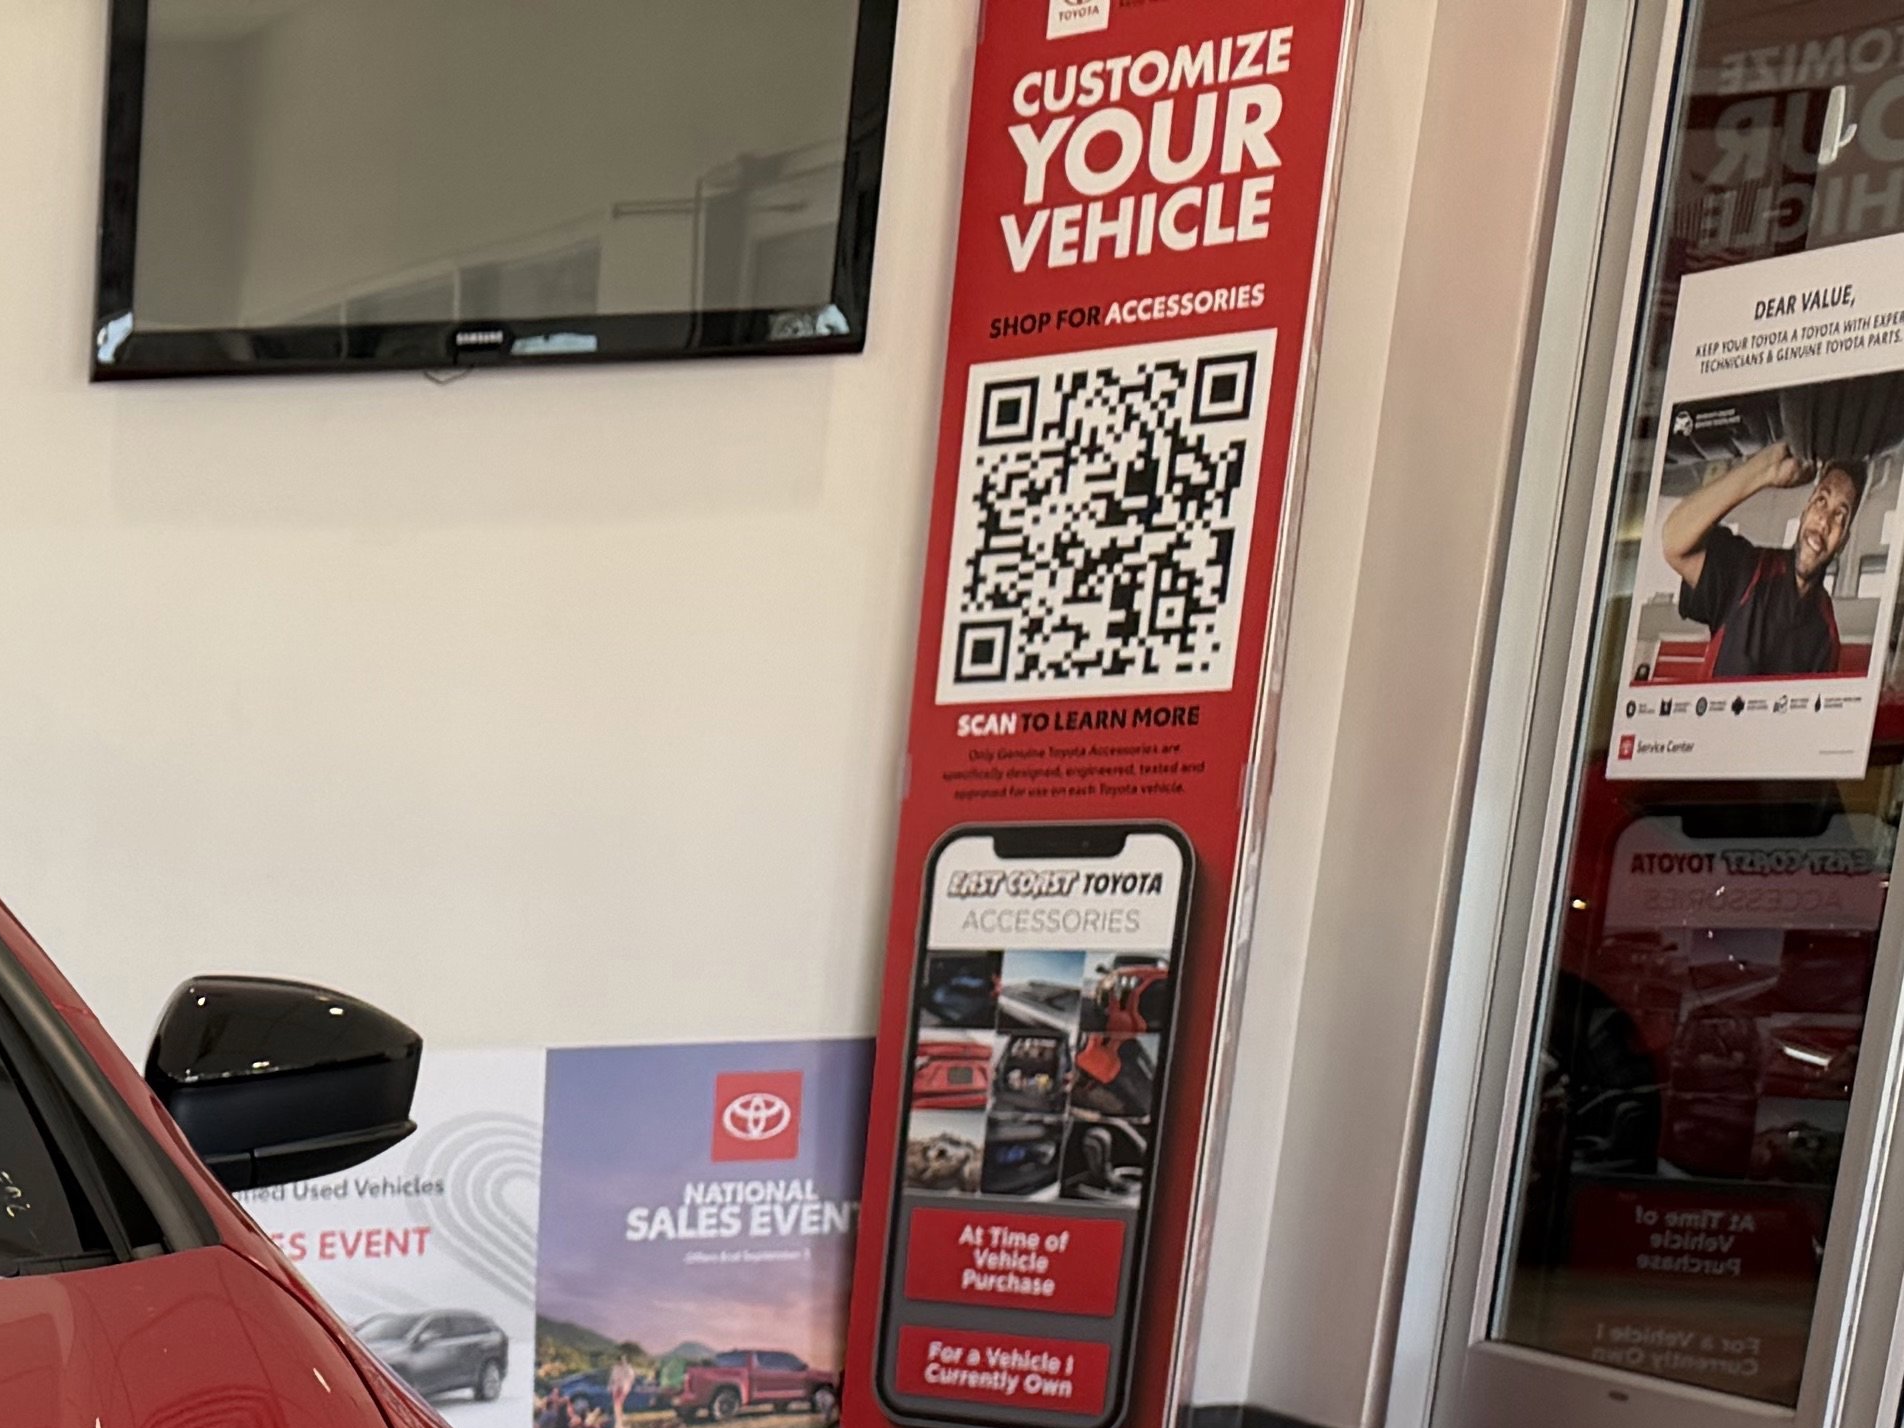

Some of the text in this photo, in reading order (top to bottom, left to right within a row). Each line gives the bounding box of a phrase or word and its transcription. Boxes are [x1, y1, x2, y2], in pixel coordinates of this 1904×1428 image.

[1059, 5, 1099, 22] TOYOTA
[1012, 26, 1293, 117] CUSTOMIZE
[1007, 83, 1283, 205] YOUR
[1000, 174, 1274, 273] VEHICLE
[989, 283, 1265, 339] SHOP FOR ACCESSORIES
[1754, 284, 1856, 320] DEAR VALUE,
[1696, 340, 1719, 358] KEEP
[1722, 335, 1748, 355] YOUR
[1751, 330, 1788, 349] TOYOTA
[1791, 328, 1798, 342] A
[1801, 322, 1839, 343] TOYOTA
[1843, 316, 1871, 333] WITH
[1700, 352, 1763, 374] TECHNICIANS
[1776, 342, 1822, 362] GENUINE
[1825, 335, 1864, 355] TOYOTA
[957, 705, 1200, 737] SCAN TO LEARN MORE
[1636, 739, 1695, 753] Service Center
[947, 870, 1163, 899] EAST COAST TOYOTA
[961, 908, 1140, 933] ACCESSORIES
[294, 1179, 348, 1200] Used
[354, 1175, 444, 1198] Vehicles
[683, 1178, 819, 1205] NATIONAL
[626, 1204, 742, 1241] SALES
[959, 1224, 1070, 1252] At Time of
[319, 1227, 431, 1260] EVENT
[973, 1248, 1049, 1273] Vehicle
[961, 1268, 1055, 1296] Purchase
[928, 1341, 963, 1363] For
[967, 1348, 980, 1365] a
[986, 1347, 1061, 1375] Vehicle
[925, 1363, 1073, 1397] Currently Own
